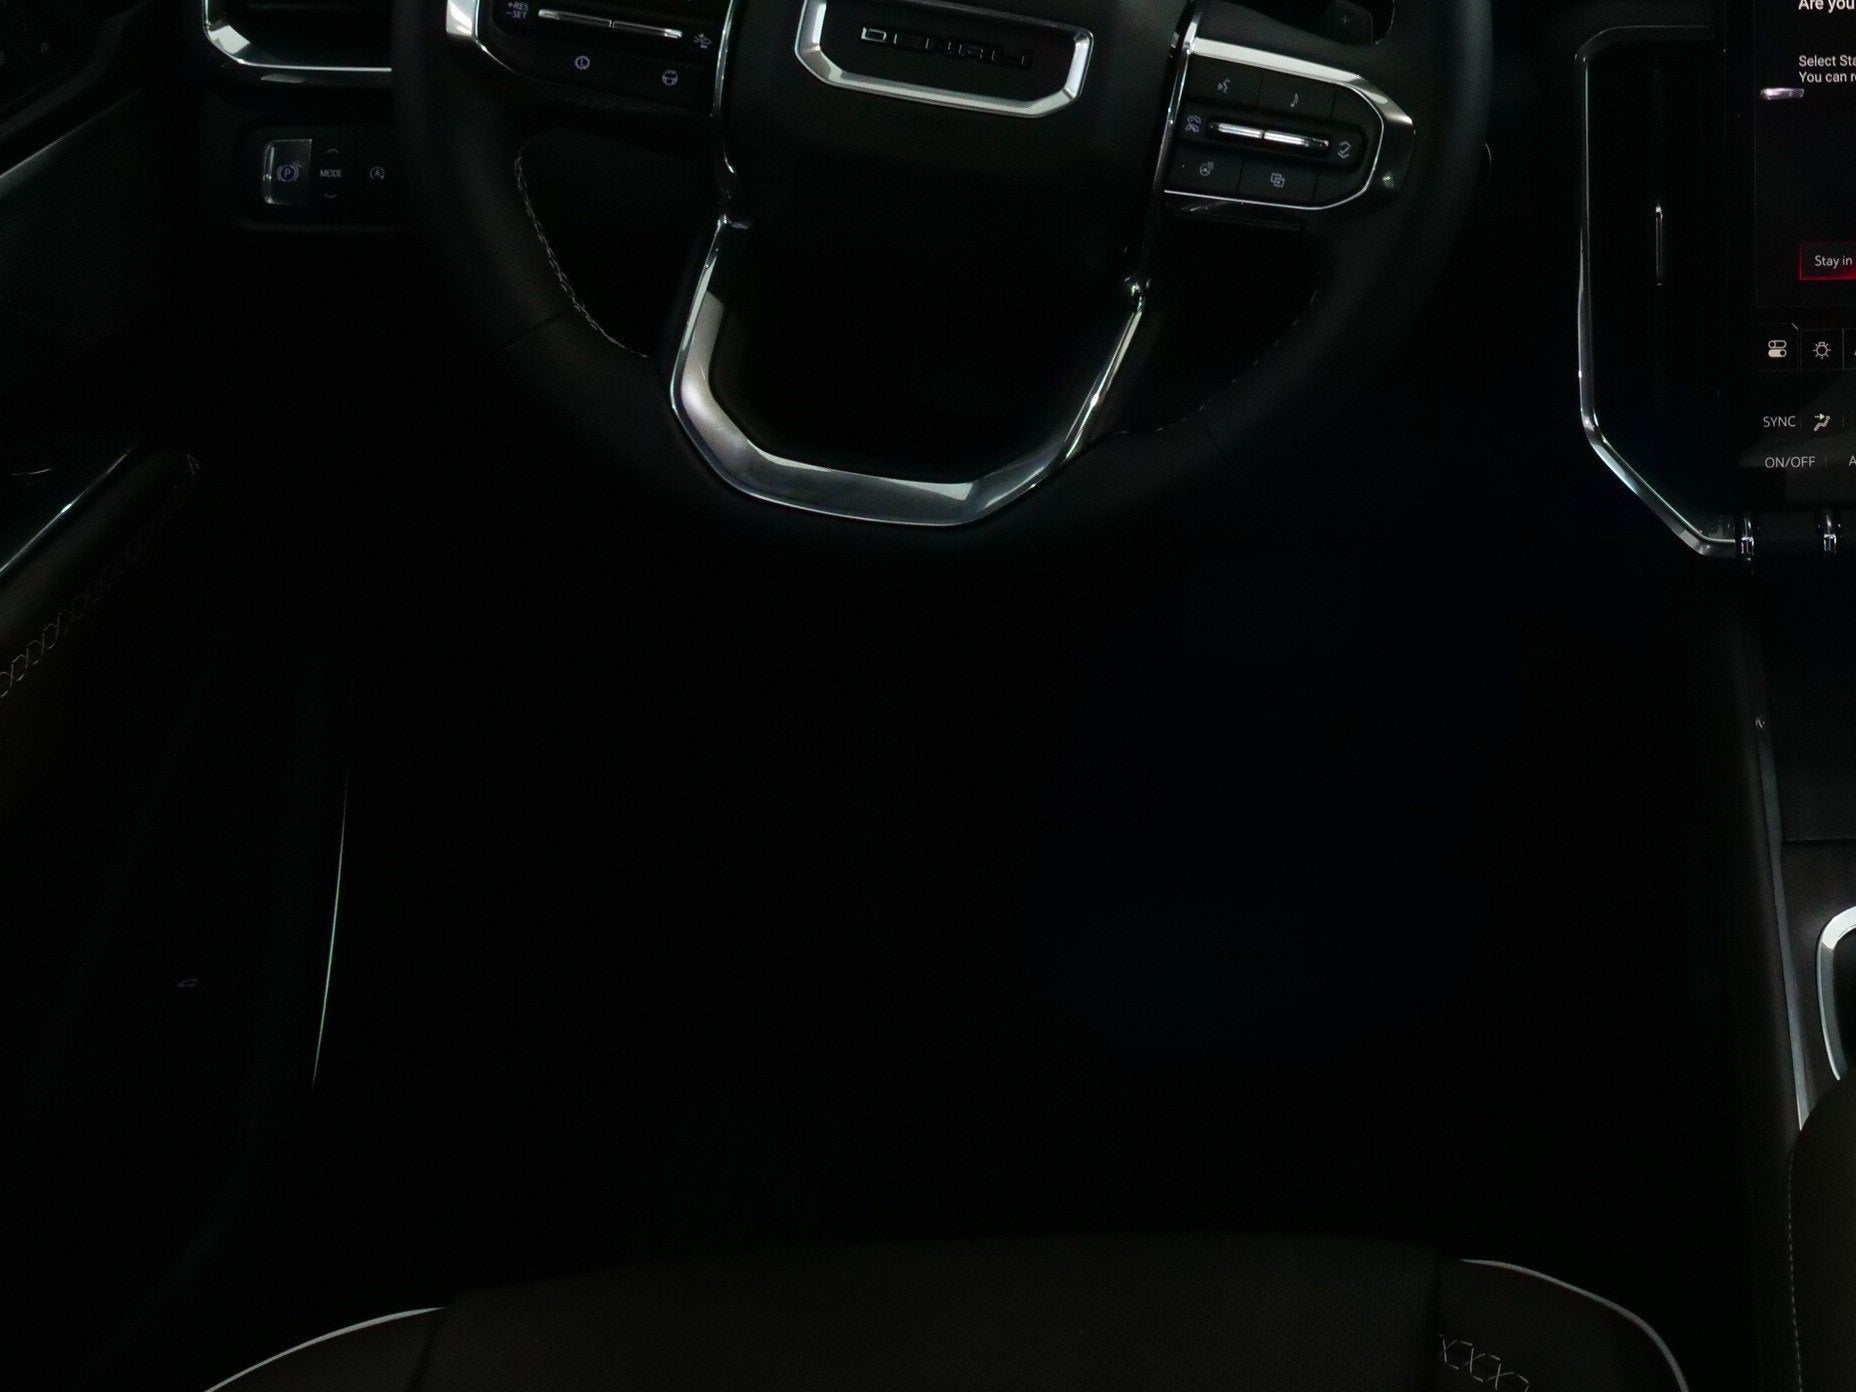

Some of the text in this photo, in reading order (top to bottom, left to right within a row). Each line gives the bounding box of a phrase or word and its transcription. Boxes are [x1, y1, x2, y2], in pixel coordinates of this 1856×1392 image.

[1798, 54, 1837, 68] Select
[1798, 71, 1822, 83] You
[1825, 73, 1848, 83] can
[319, 169, 343, 178] MODE
[1814, 255, 1841, 269] Stay
[1841, 254, 1853, 266] in
[1762, 415, 1796, 428] SYNC
[1764, 455, 1816, 469] ON/OFF
